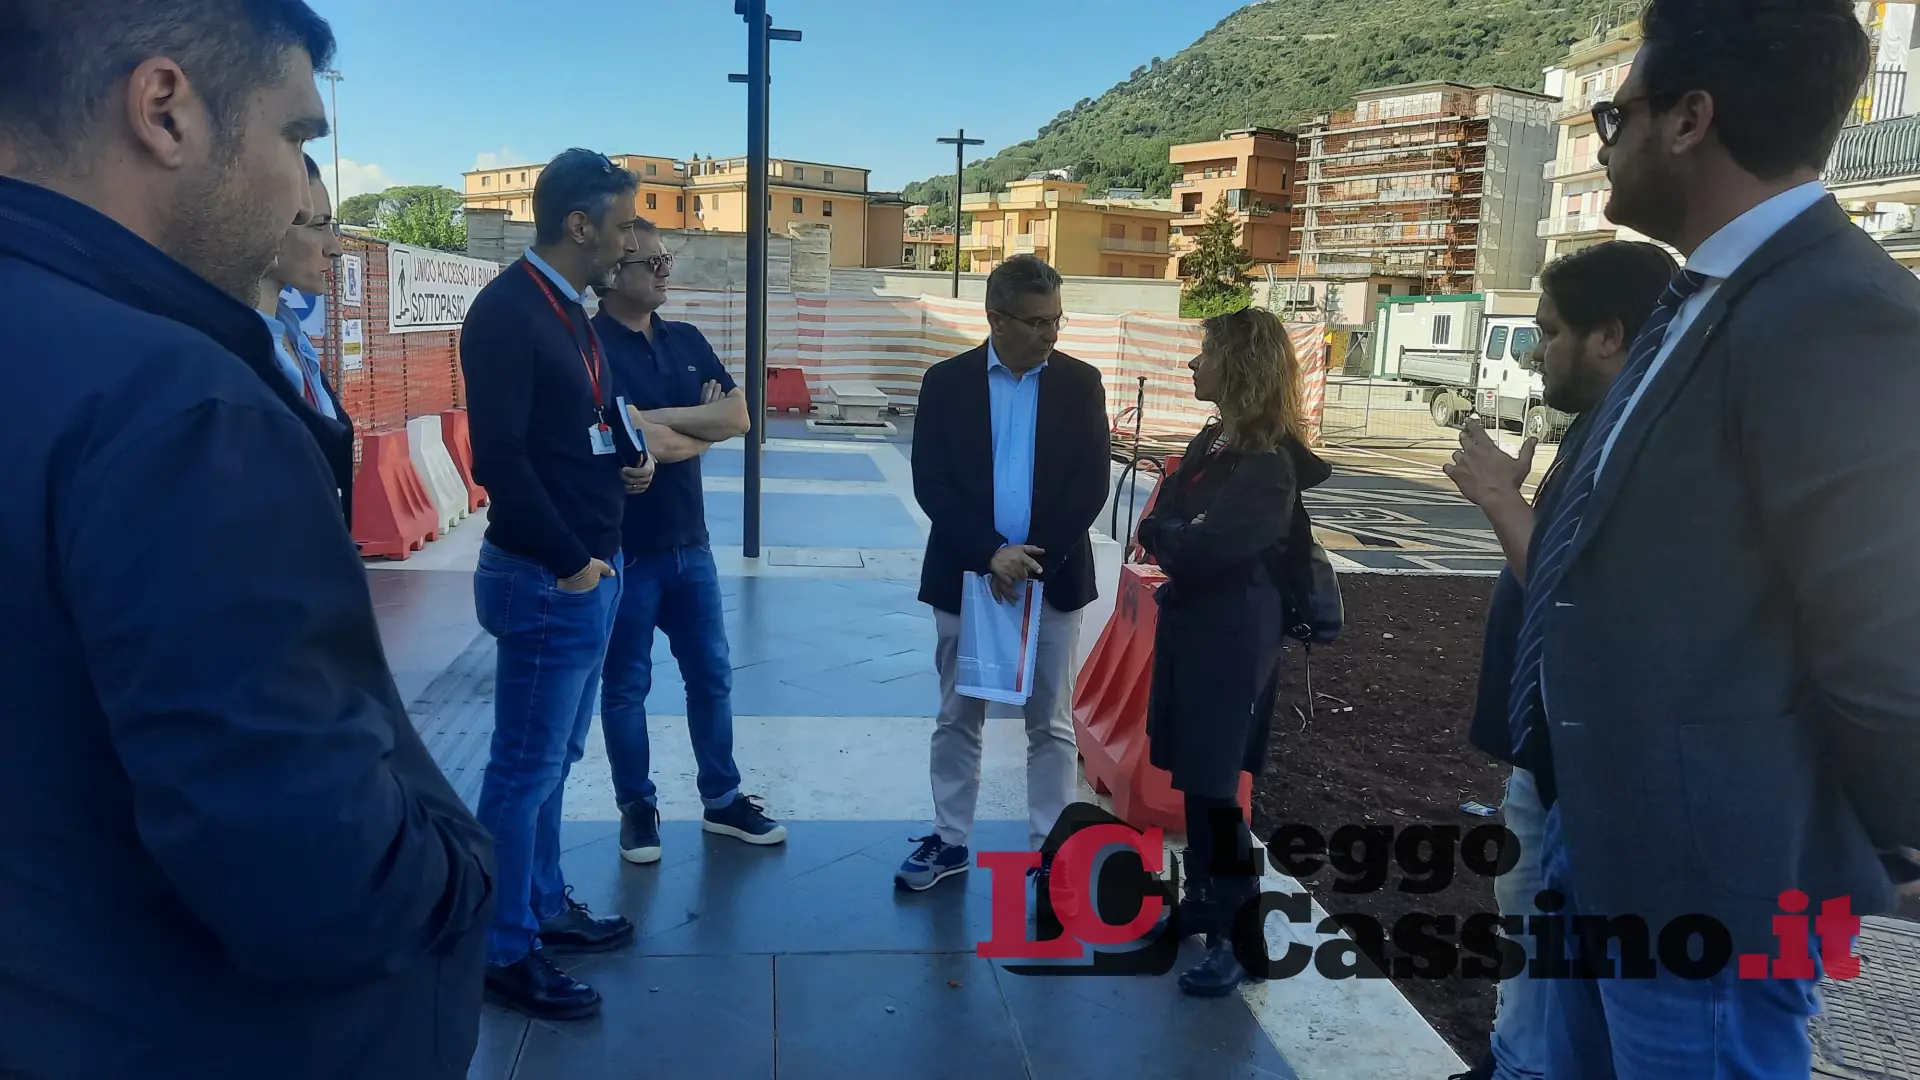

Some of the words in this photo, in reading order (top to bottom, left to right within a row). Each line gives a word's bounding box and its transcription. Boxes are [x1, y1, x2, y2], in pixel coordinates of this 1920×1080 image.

[414, 256, 436, 282] UNICO
[438, 261, 469, 286] ACCESSO
[471, 266, 477, 287] AI
[412, 293, 465, 322] SOTTOPASSO
